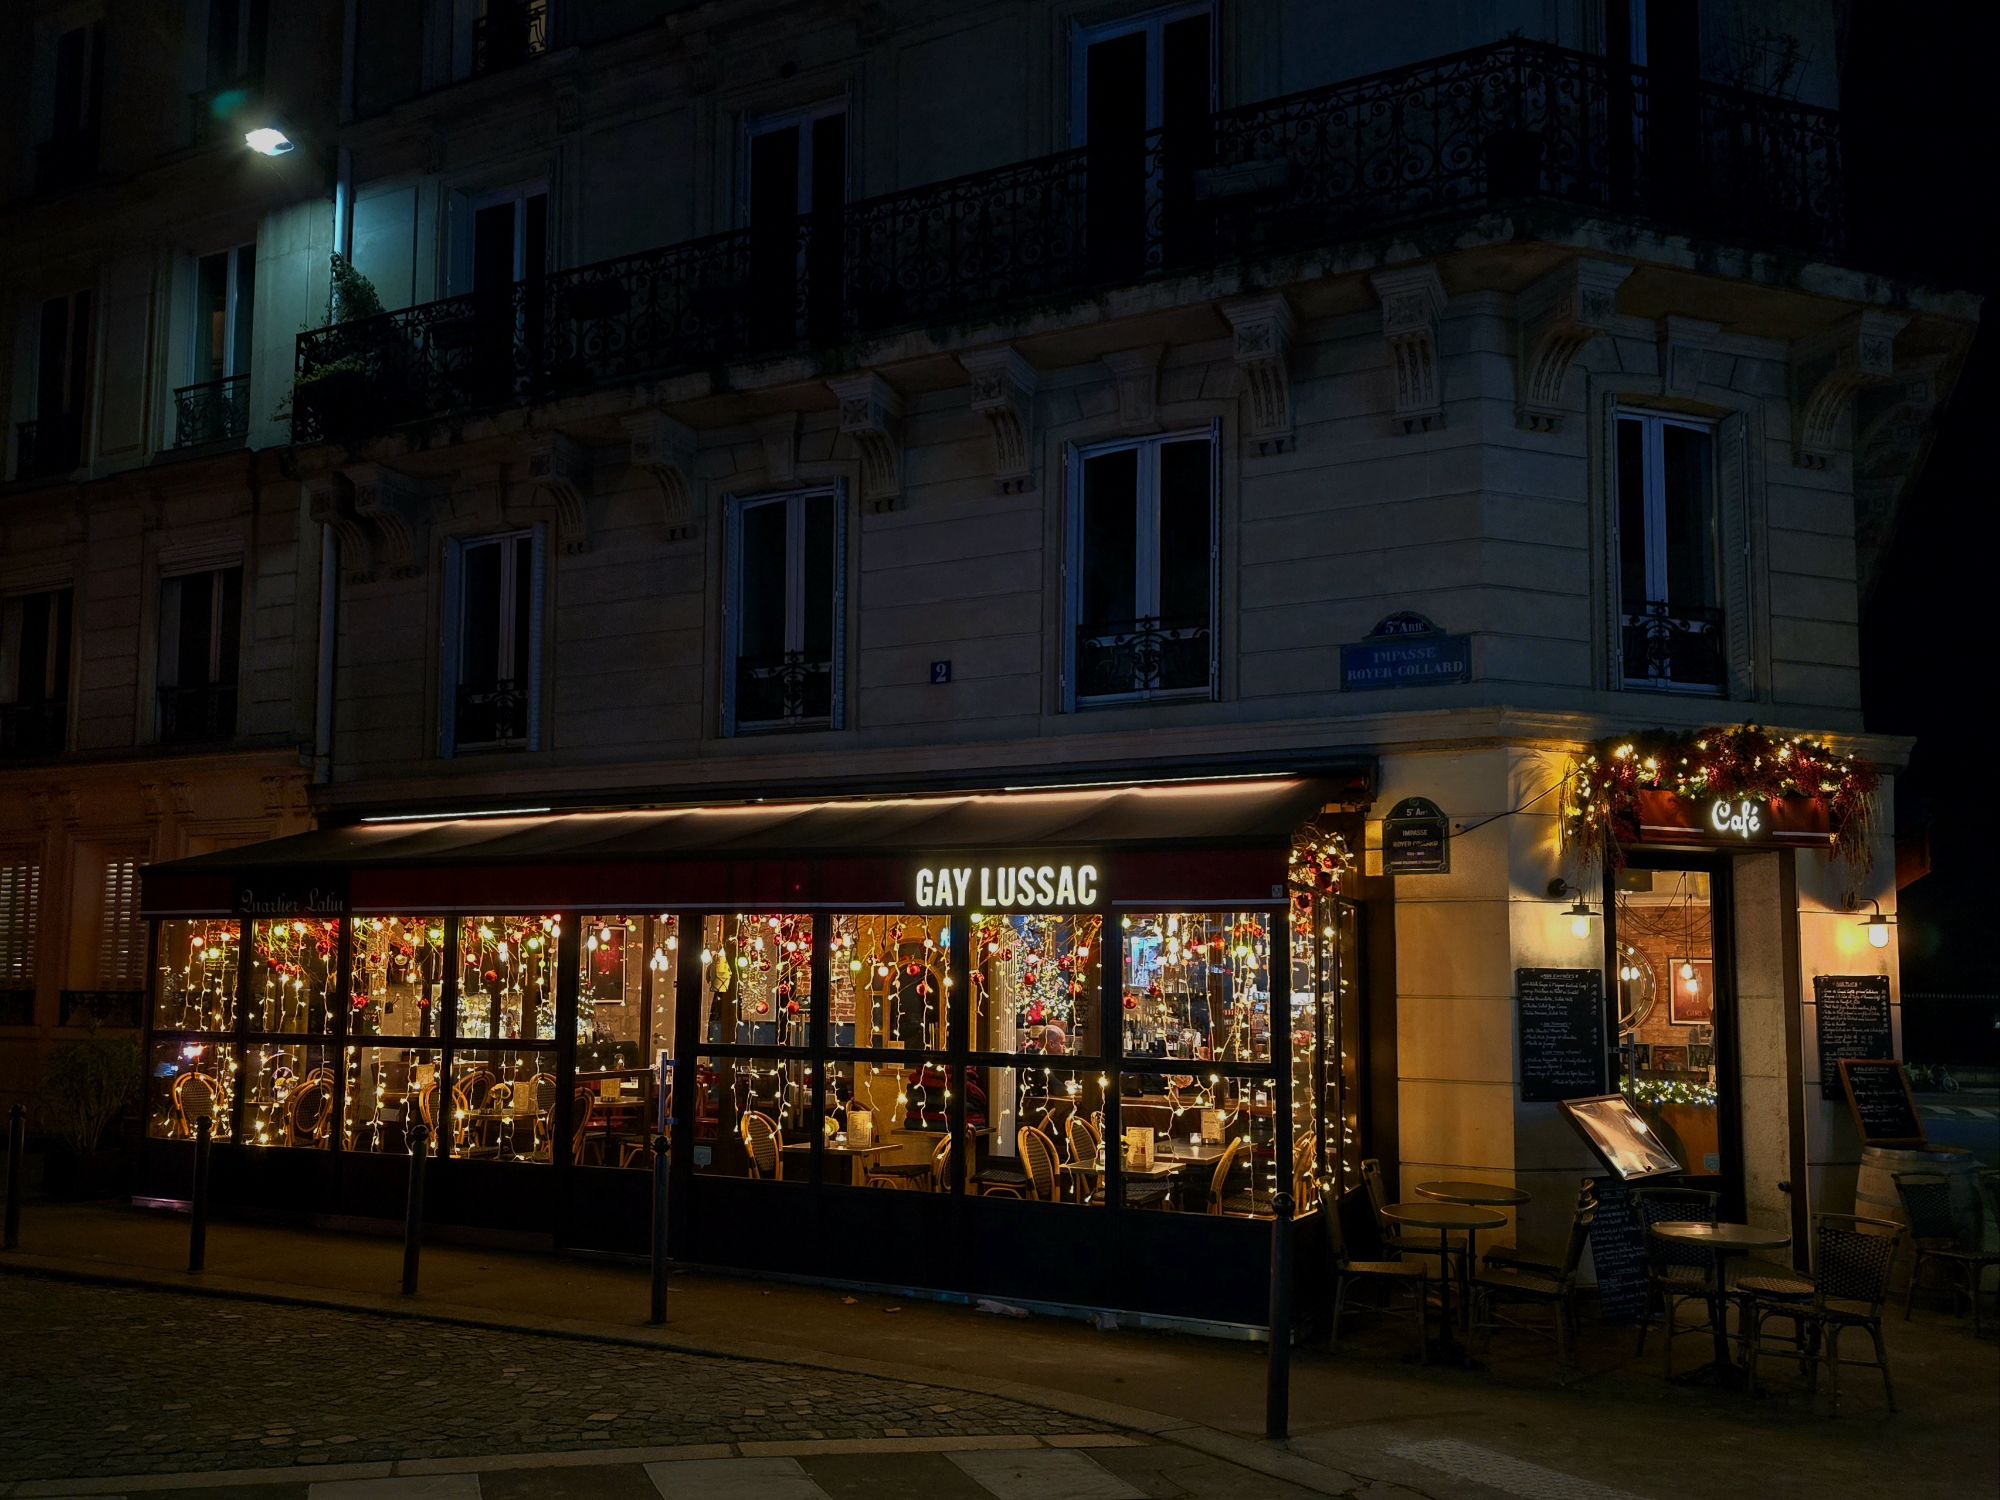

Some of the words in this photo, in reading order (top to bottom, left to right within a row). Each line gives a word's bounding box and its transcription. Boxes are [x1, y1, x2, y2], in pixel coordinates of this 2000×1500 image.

[1373, 647, 1437, 664] IMPASSE
[935, 663, 947, 683] 2
[1711, 799, 1761, 840] Café
[916, 867, 972, 907] GAY
[980, 864, 1097, 907] LUSSAC
[239, 888, 300, 913] Quartier
[303, 887, 344, 913] Latin
